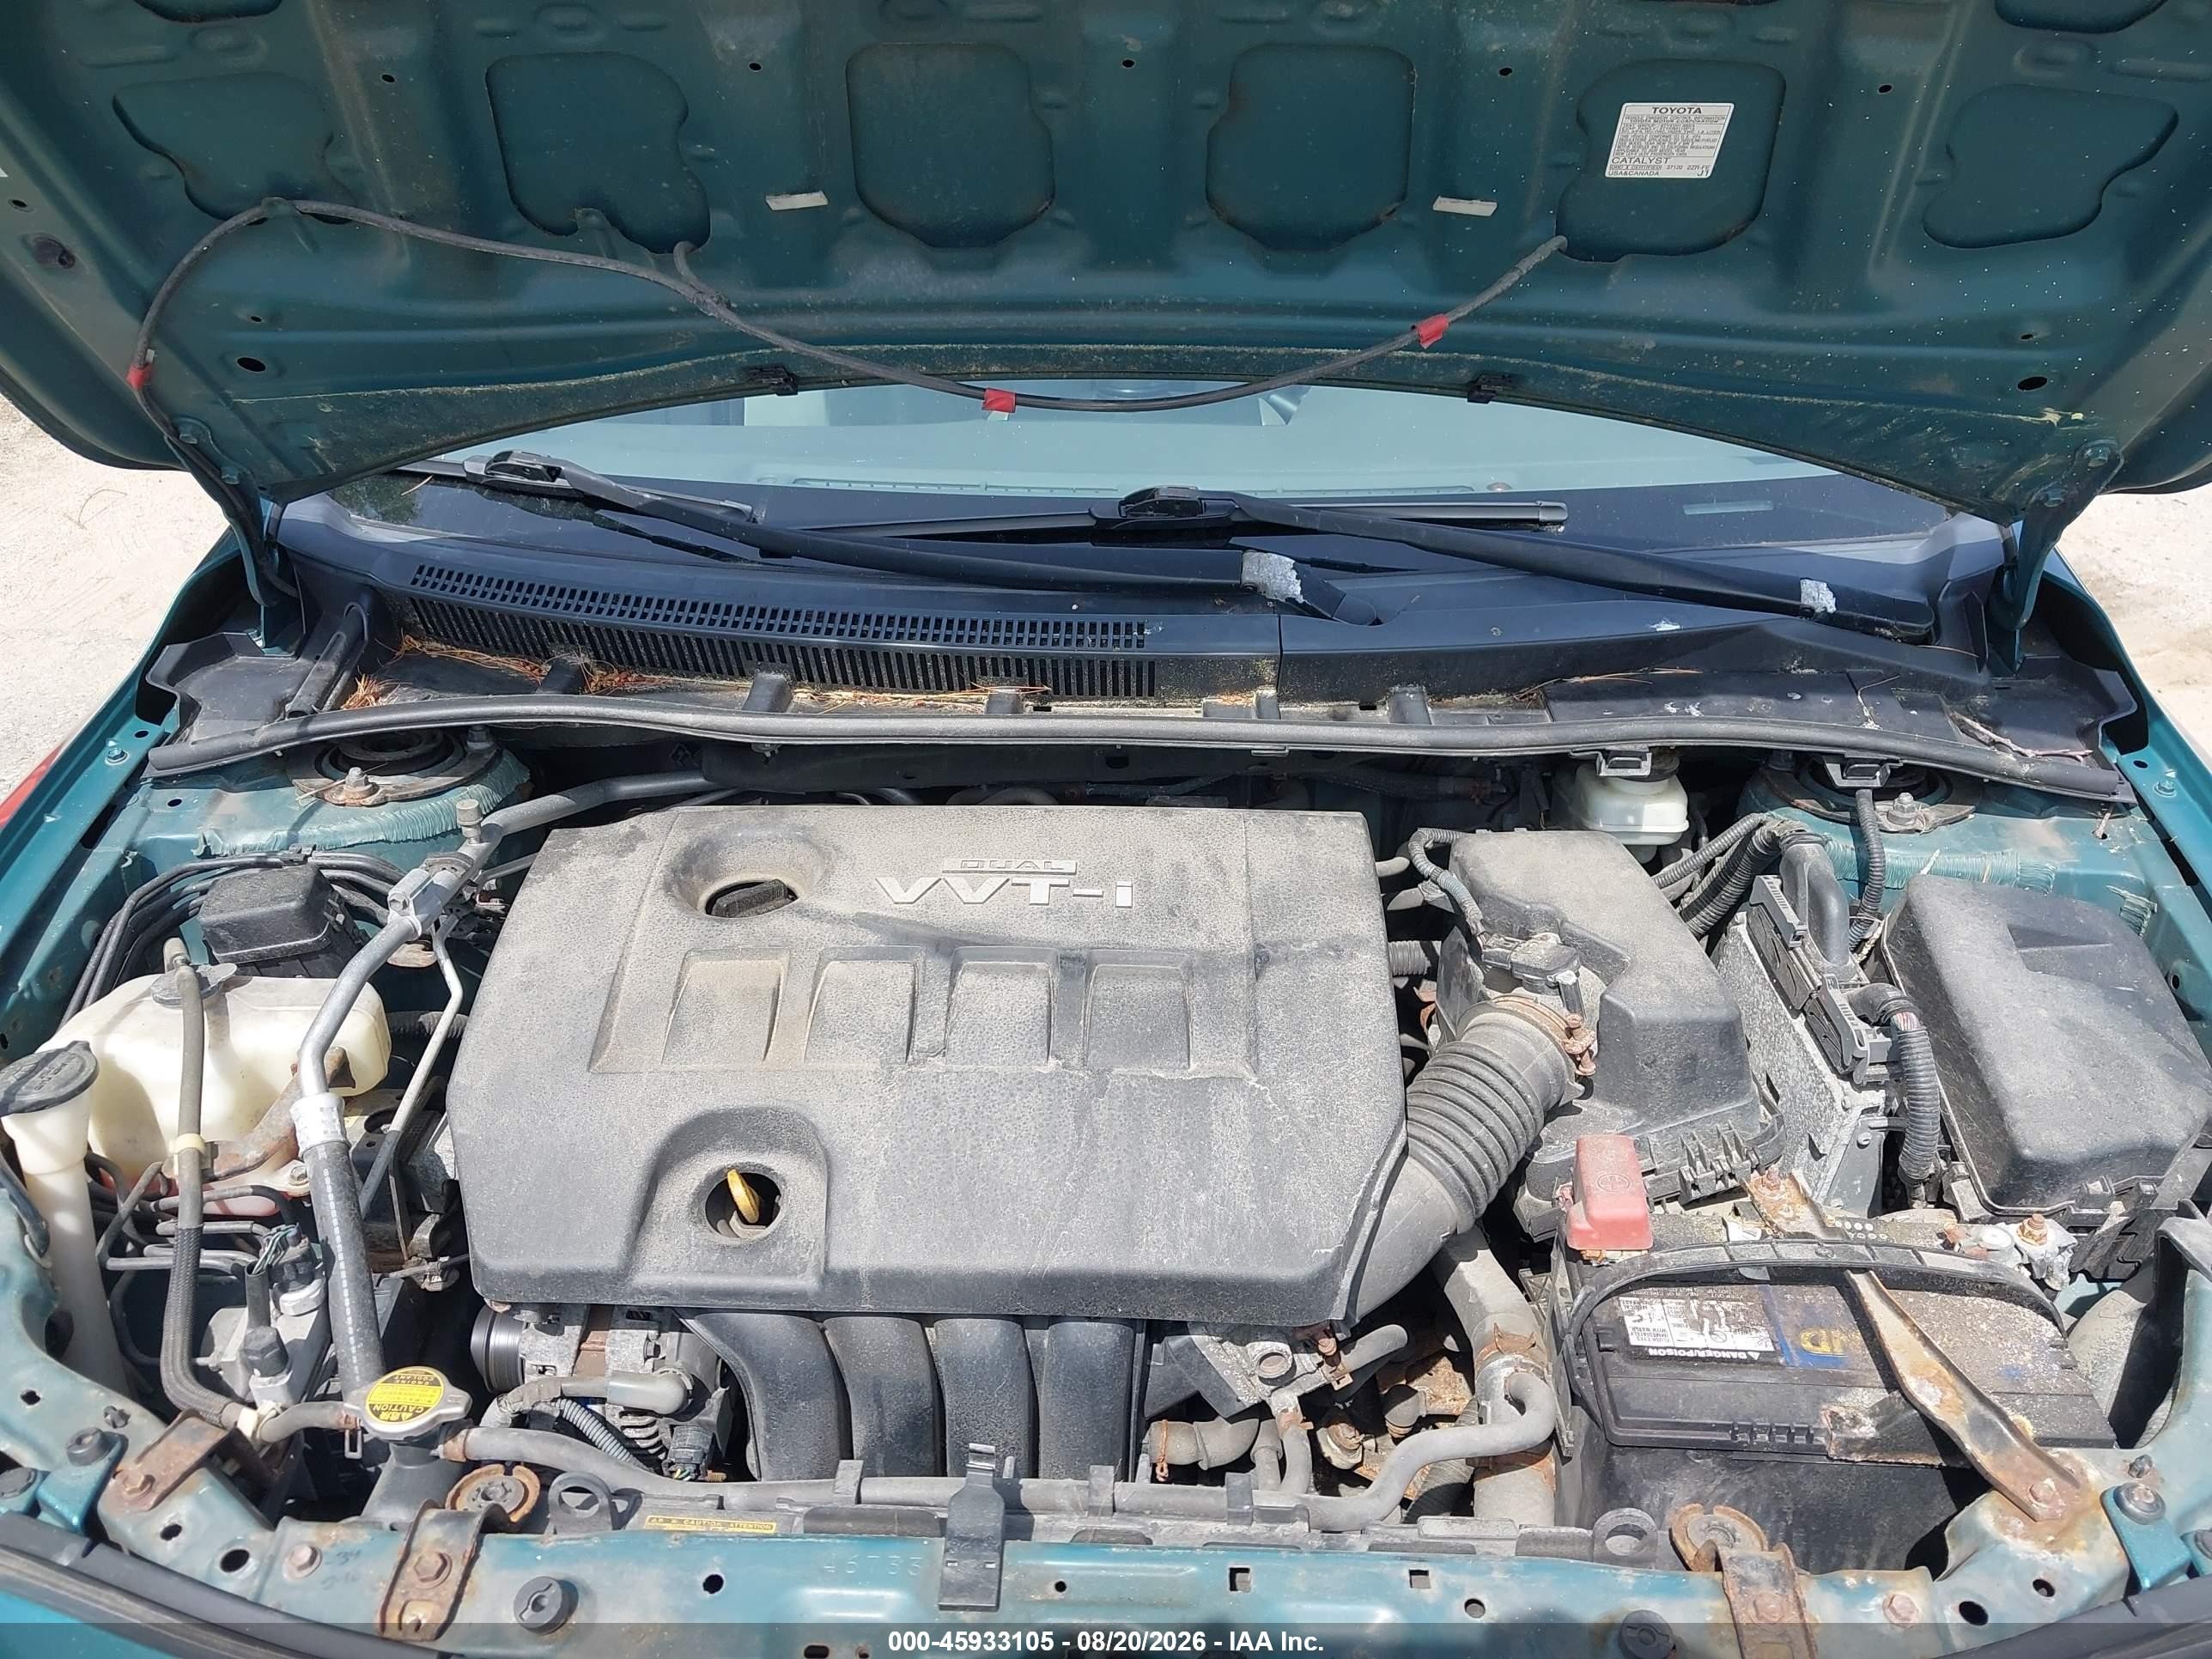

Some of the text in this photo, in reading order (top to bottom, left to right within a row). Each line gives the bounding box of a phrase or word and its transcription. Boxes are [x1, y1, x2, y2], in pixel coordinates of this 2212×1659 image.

[960, 859, 1066, 870] DUAL
[874, 877, 1133, 908] VVT-i
[373, 1405, 424, 1413] CAUTION
